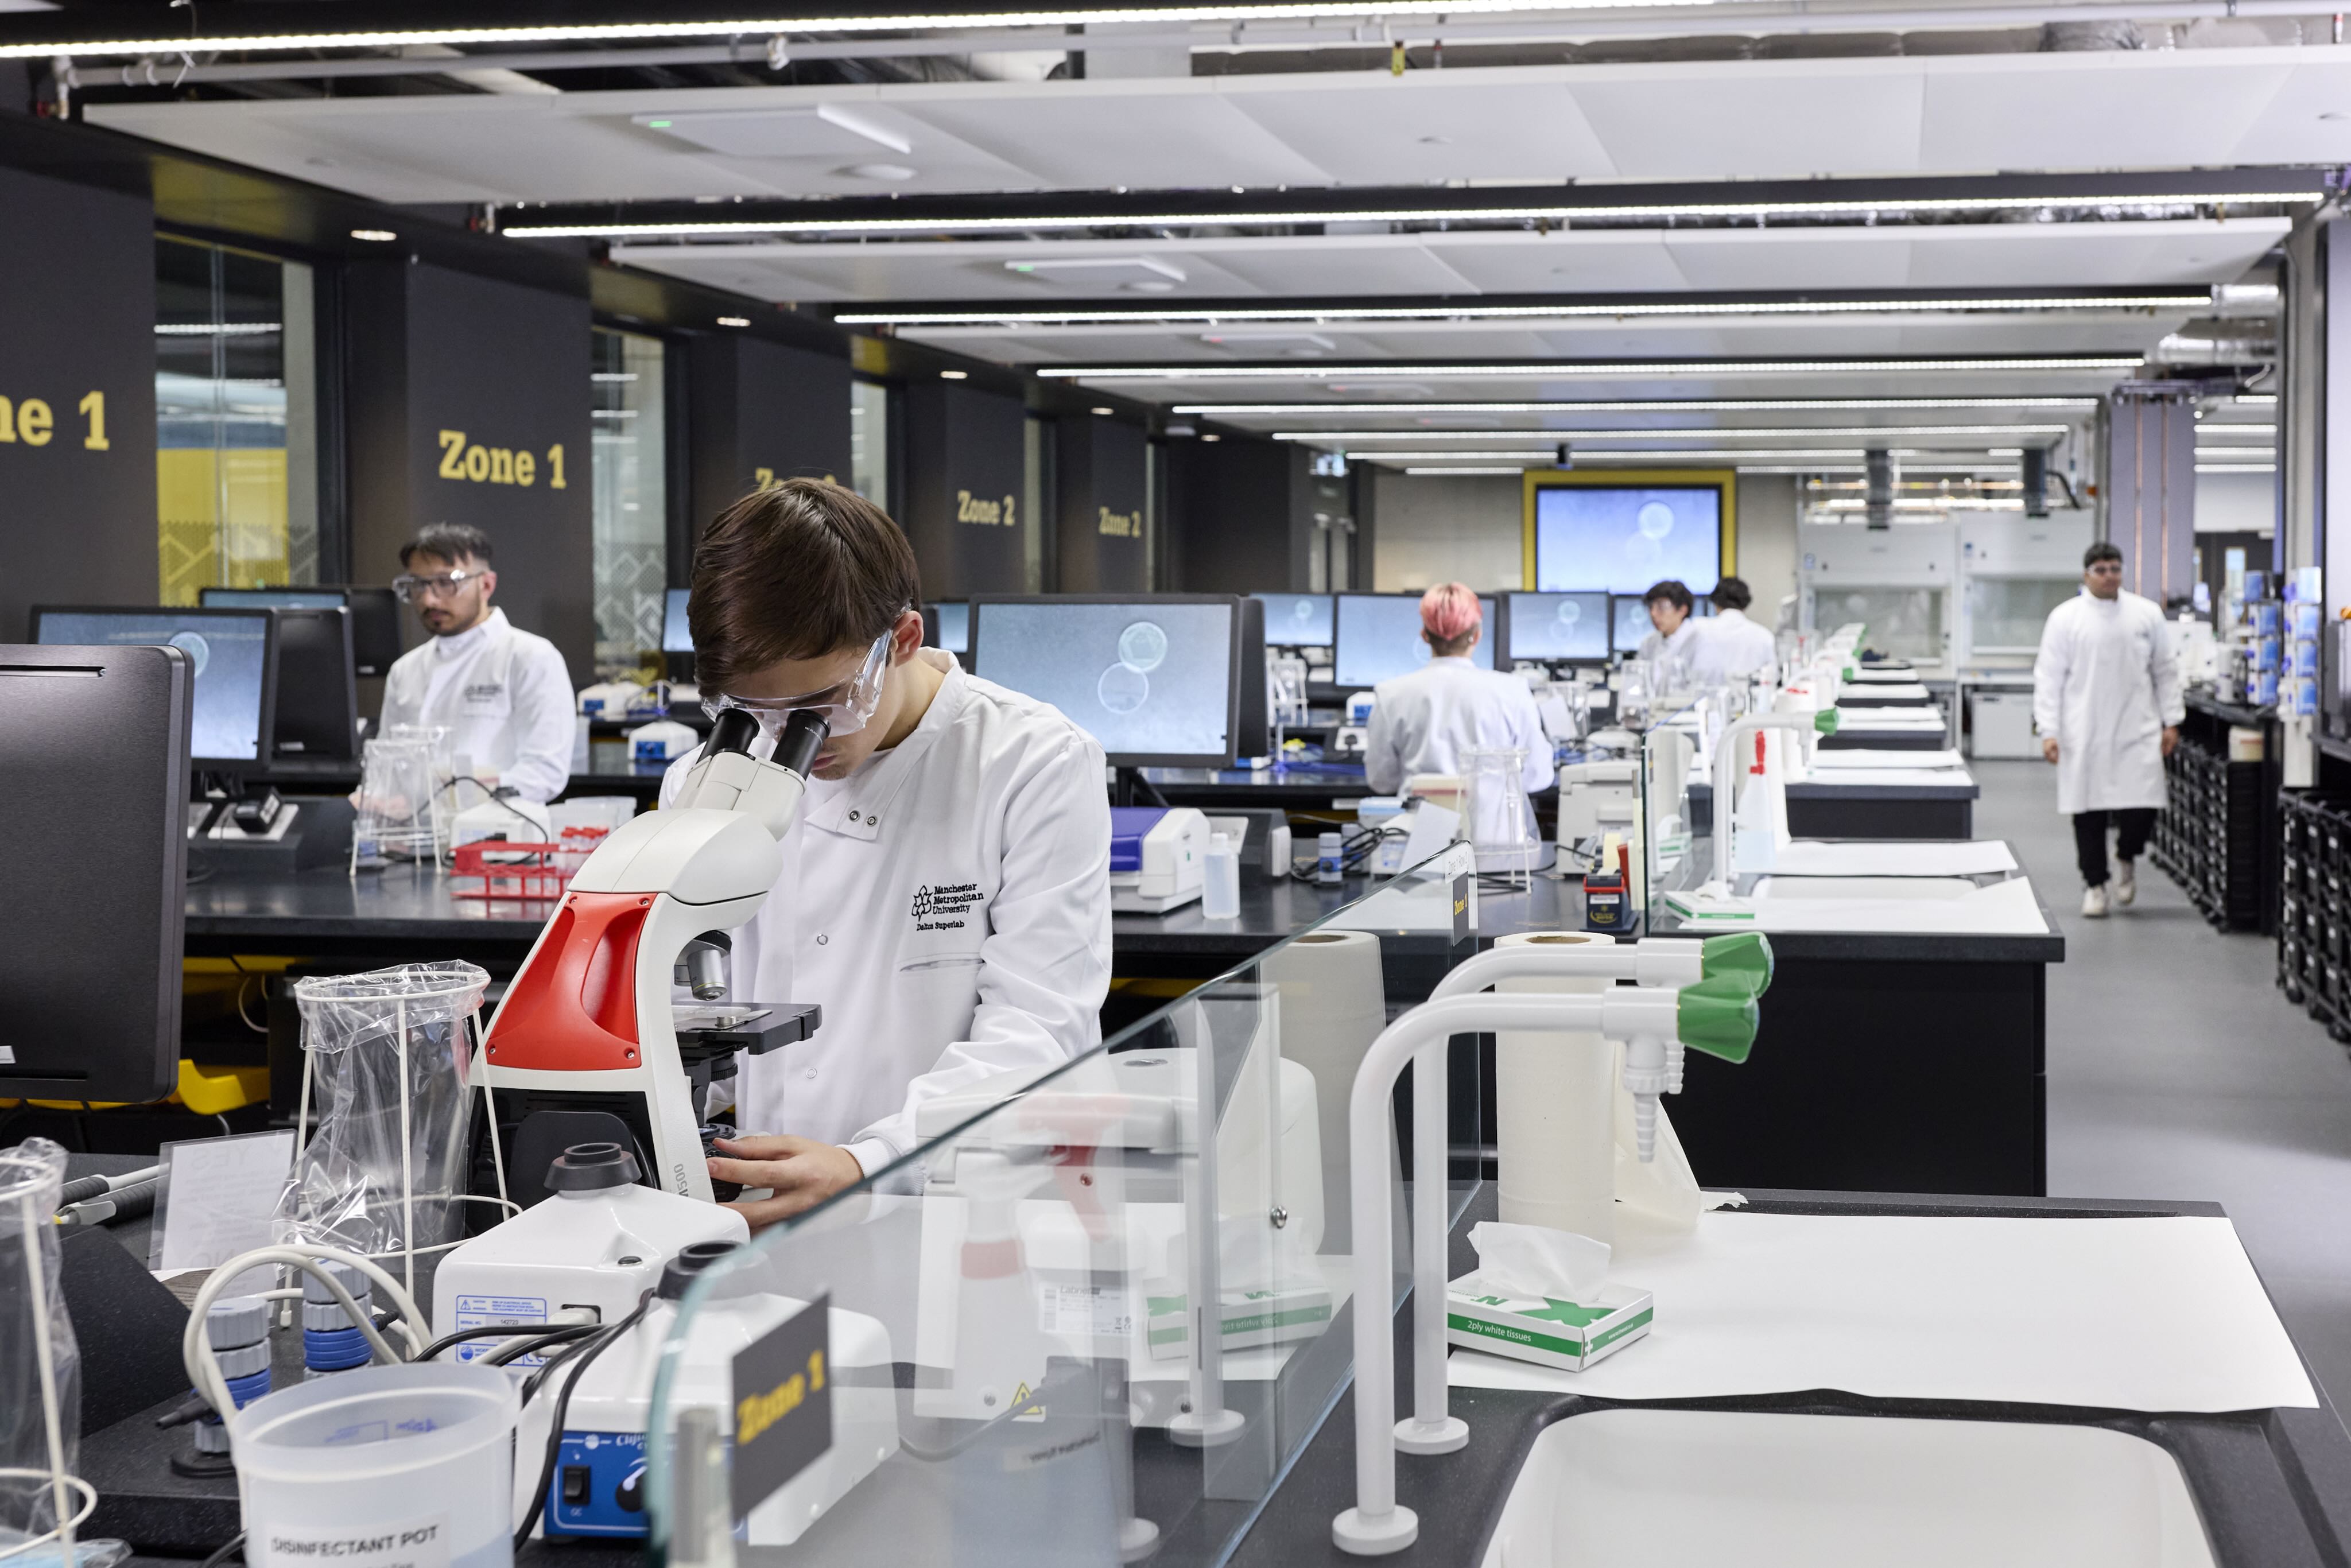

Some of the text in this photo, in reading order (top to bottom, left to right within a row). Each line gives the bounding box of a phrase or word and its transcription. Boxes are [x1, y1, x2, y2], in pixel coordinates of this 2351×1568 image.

[79, 390, 110, 451] 1
[439, 429, 567, 489] Zone 1
[957, 490, 1015, 526] Zone 2
[1099, 506, 1141, 538] Zone 2
[933, 892, 984, 905] Metropolitan
[934, 884, 977, 895] Manchester
[933, 905, 971, 914] University
[1454, 892, 1468, 916] Zone 1
[917, 920, 965, 931] Dalton Superlab
[1468, 1321, 1531, 1342] 2ply white tissues
[736, 1349, 825, 1447] Zone 1
[271, 1524, 439, 1557] DISINFECTANT POT
